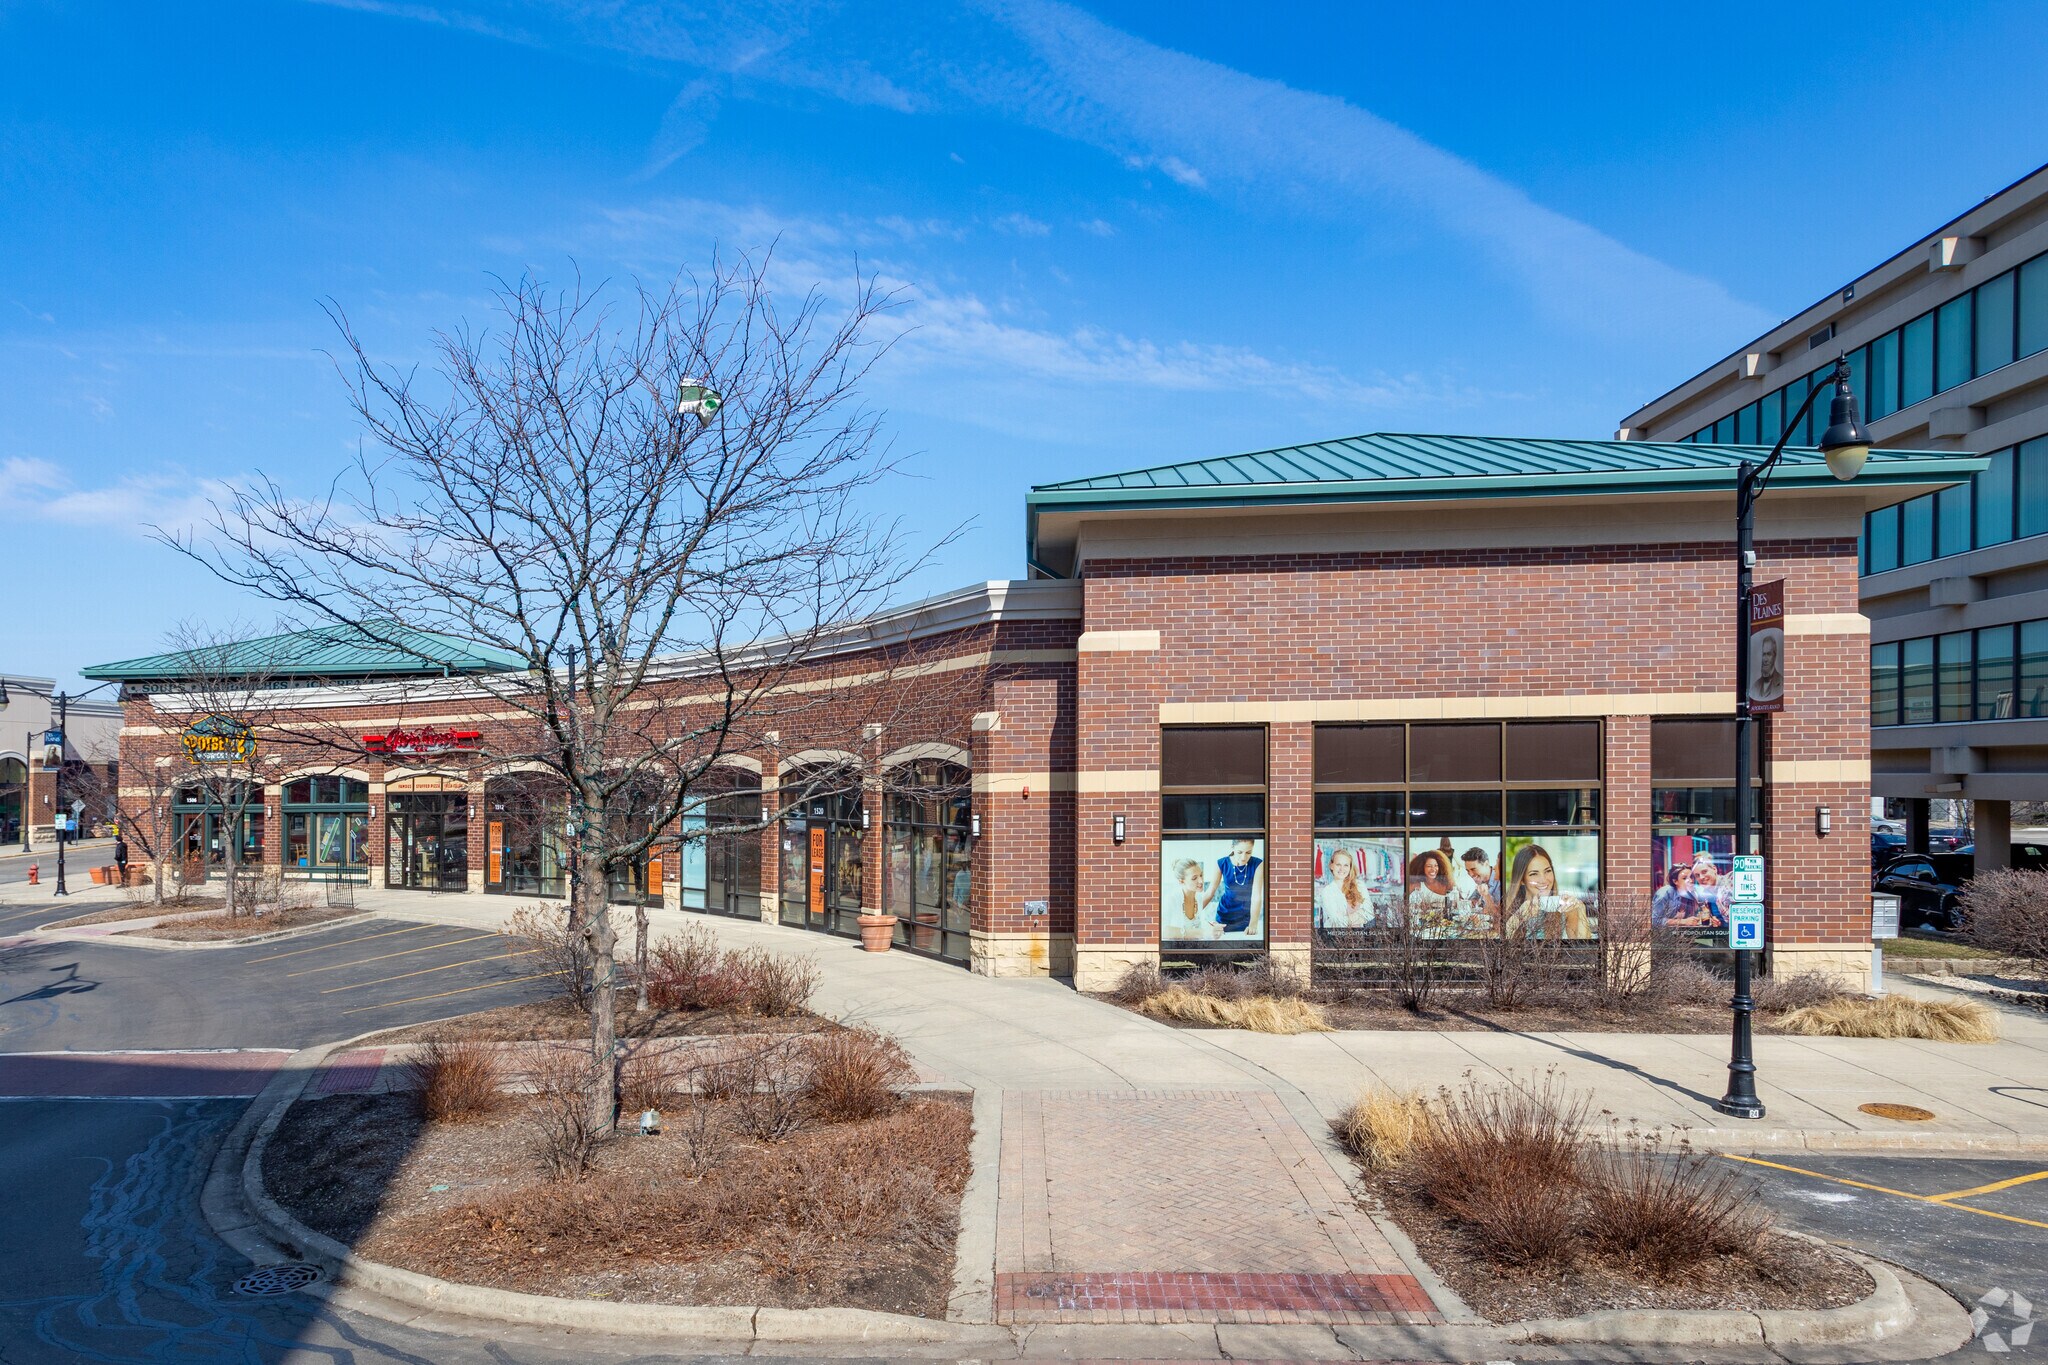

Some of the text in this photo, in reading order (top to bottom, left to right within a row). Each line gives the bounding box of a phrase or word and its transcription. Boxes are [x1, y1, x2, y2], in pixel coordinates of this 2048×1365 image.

[1753, 593, 1767, 606] DES
[1753, 603, 1781, 620] PLAINES
[184, 731, 248, 754] POTBEY
[814, 807, 824, 815] 1520
[812, 834, 823, 847] FOR
[812, 848, 824, 858] LEASE
[1735, 859, 1745, 869] 90
[1740, 883, 1757, 891] TIMES
